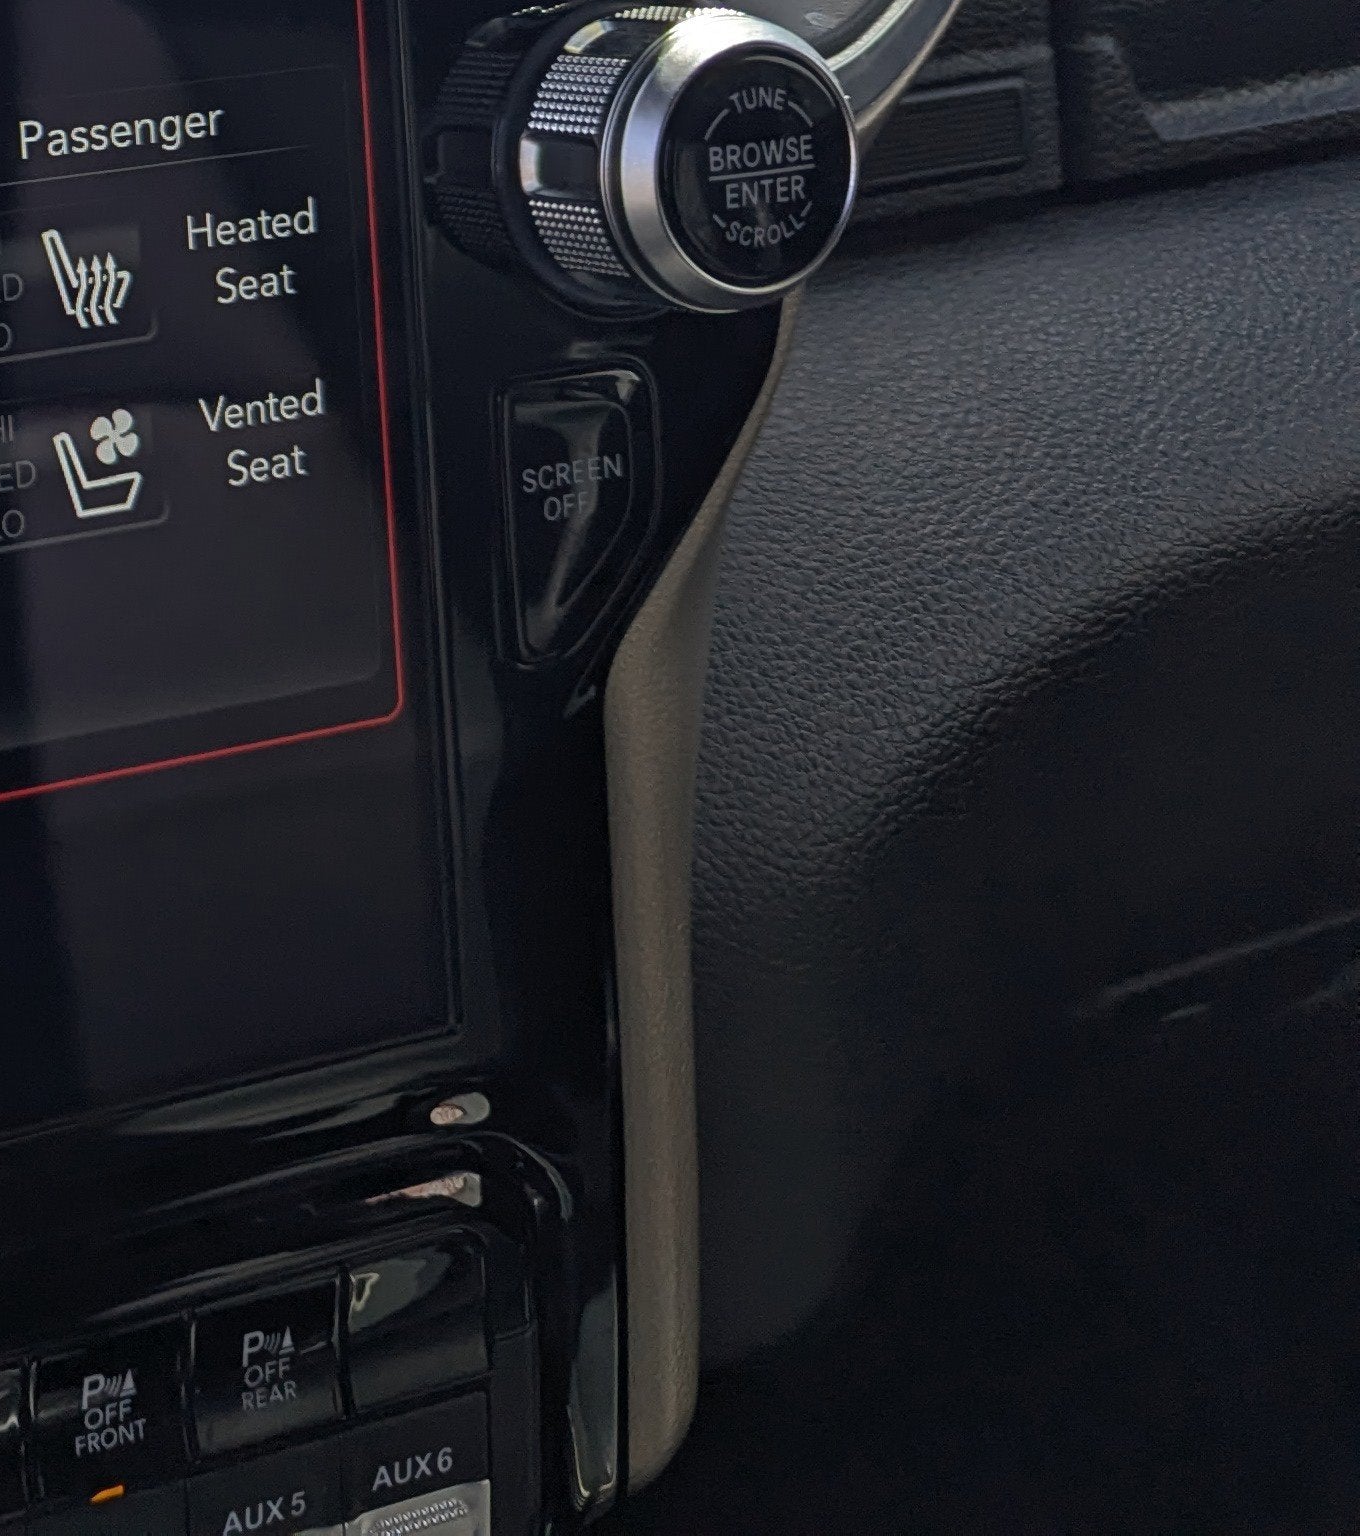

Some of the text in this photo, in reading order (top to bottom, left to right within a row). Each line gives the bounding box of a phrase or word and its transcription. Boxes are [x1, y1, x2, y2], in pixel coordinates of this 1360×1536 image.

[729, 86, 788, 113] TUNE
[18, 109, 225, 161] Passenger
[709, 135, 813, 172] BROWSE
[726, 175, 805, 209] ENTER
[186, 196, 317, 251] Heated
[726, 213, 804, 247] SCROLL
[215, 264, 297, 305] Seat
[199, 378, 327, 434] Vented
[227, 443, 308, 488] Seat
[522, 453, 623, 495] SCREEN
[543, 491, 590, 521] OFF
[244, 1355, 291, 1389] OFF
[84, 1397, 133, 1431] OFF
[241, 1381, 297, 1412] REAR
[74, 1418, 147, 1458] FRONT
[372, 1447, 454, 1492] AUX 6
[222, 1490, 308, 1536] AUX 5
